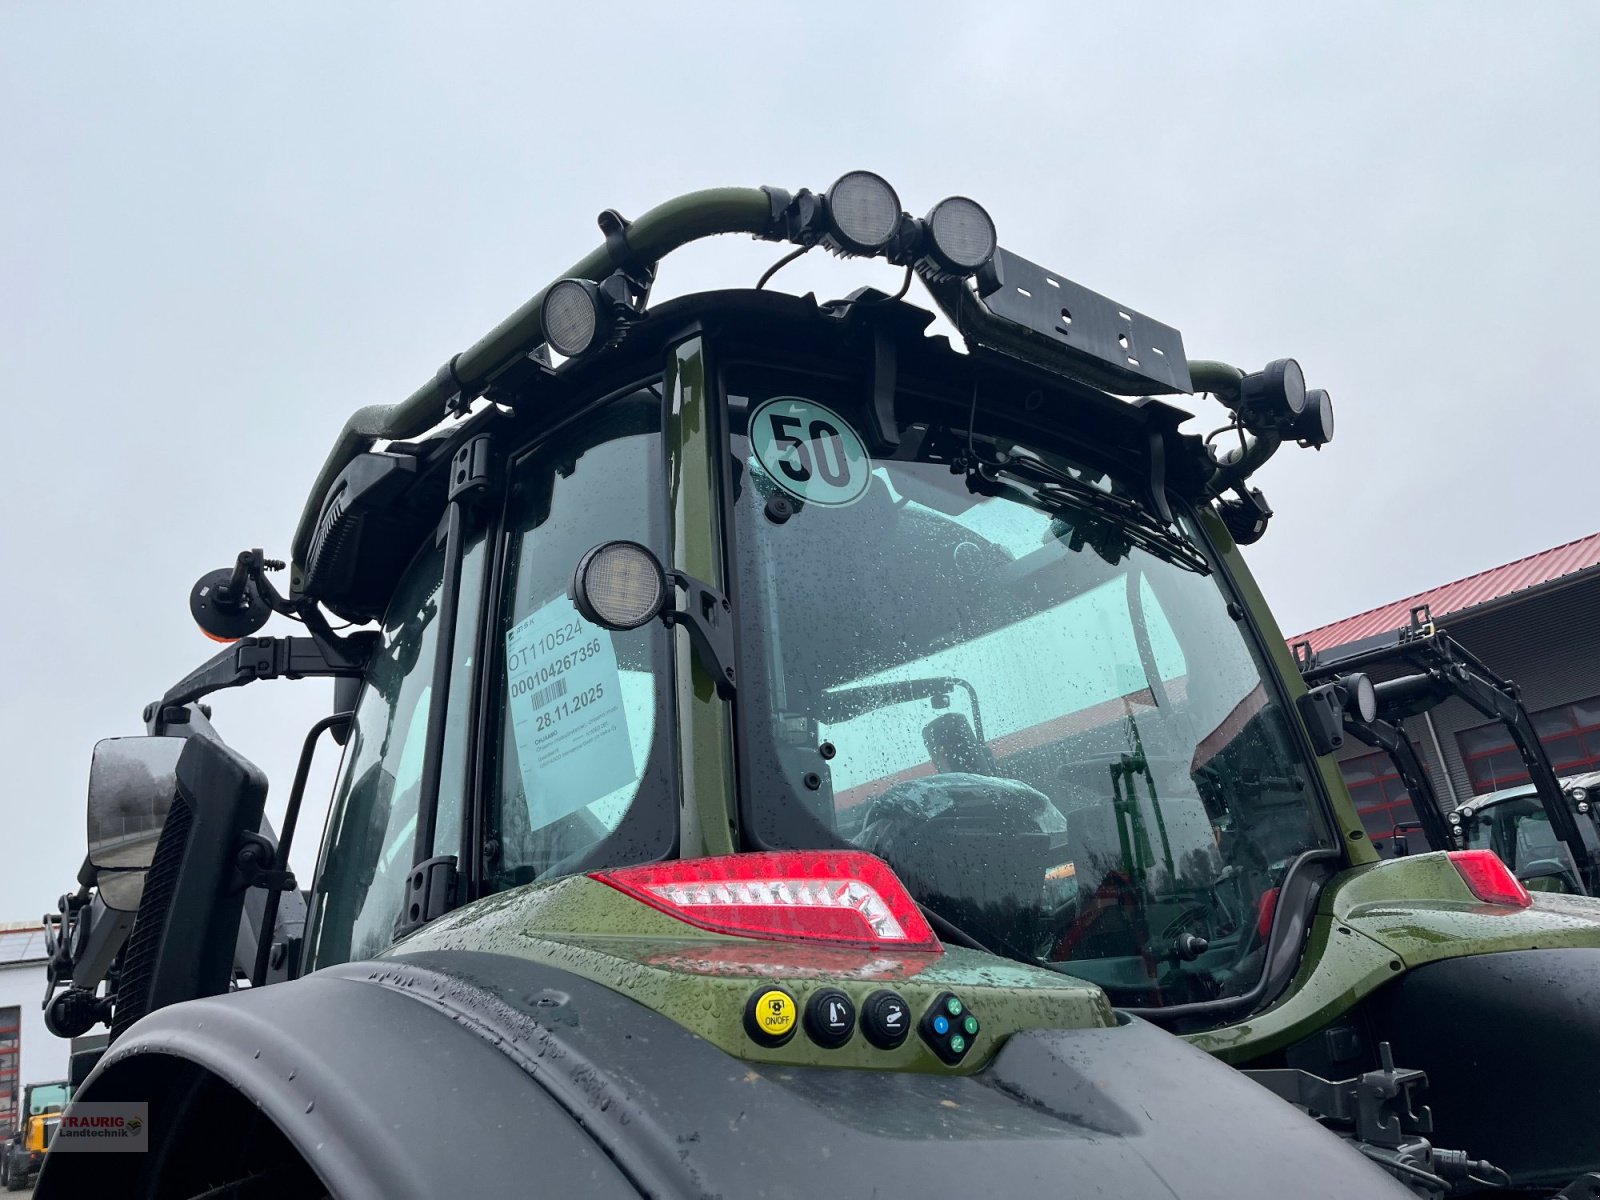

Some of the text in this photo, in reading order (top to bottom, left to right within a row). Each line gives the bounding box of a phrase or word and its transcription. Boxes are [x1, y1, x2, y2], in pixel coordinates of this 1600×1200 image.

[769, 414, 850, 487] 50
[508, 618, 583, 672] OT110524
[511, 638, 600, 698] 000104267356
[536, 682, 604, 732] 28.11.2025
[765, 1016, 789, 1026] ON/OFF
